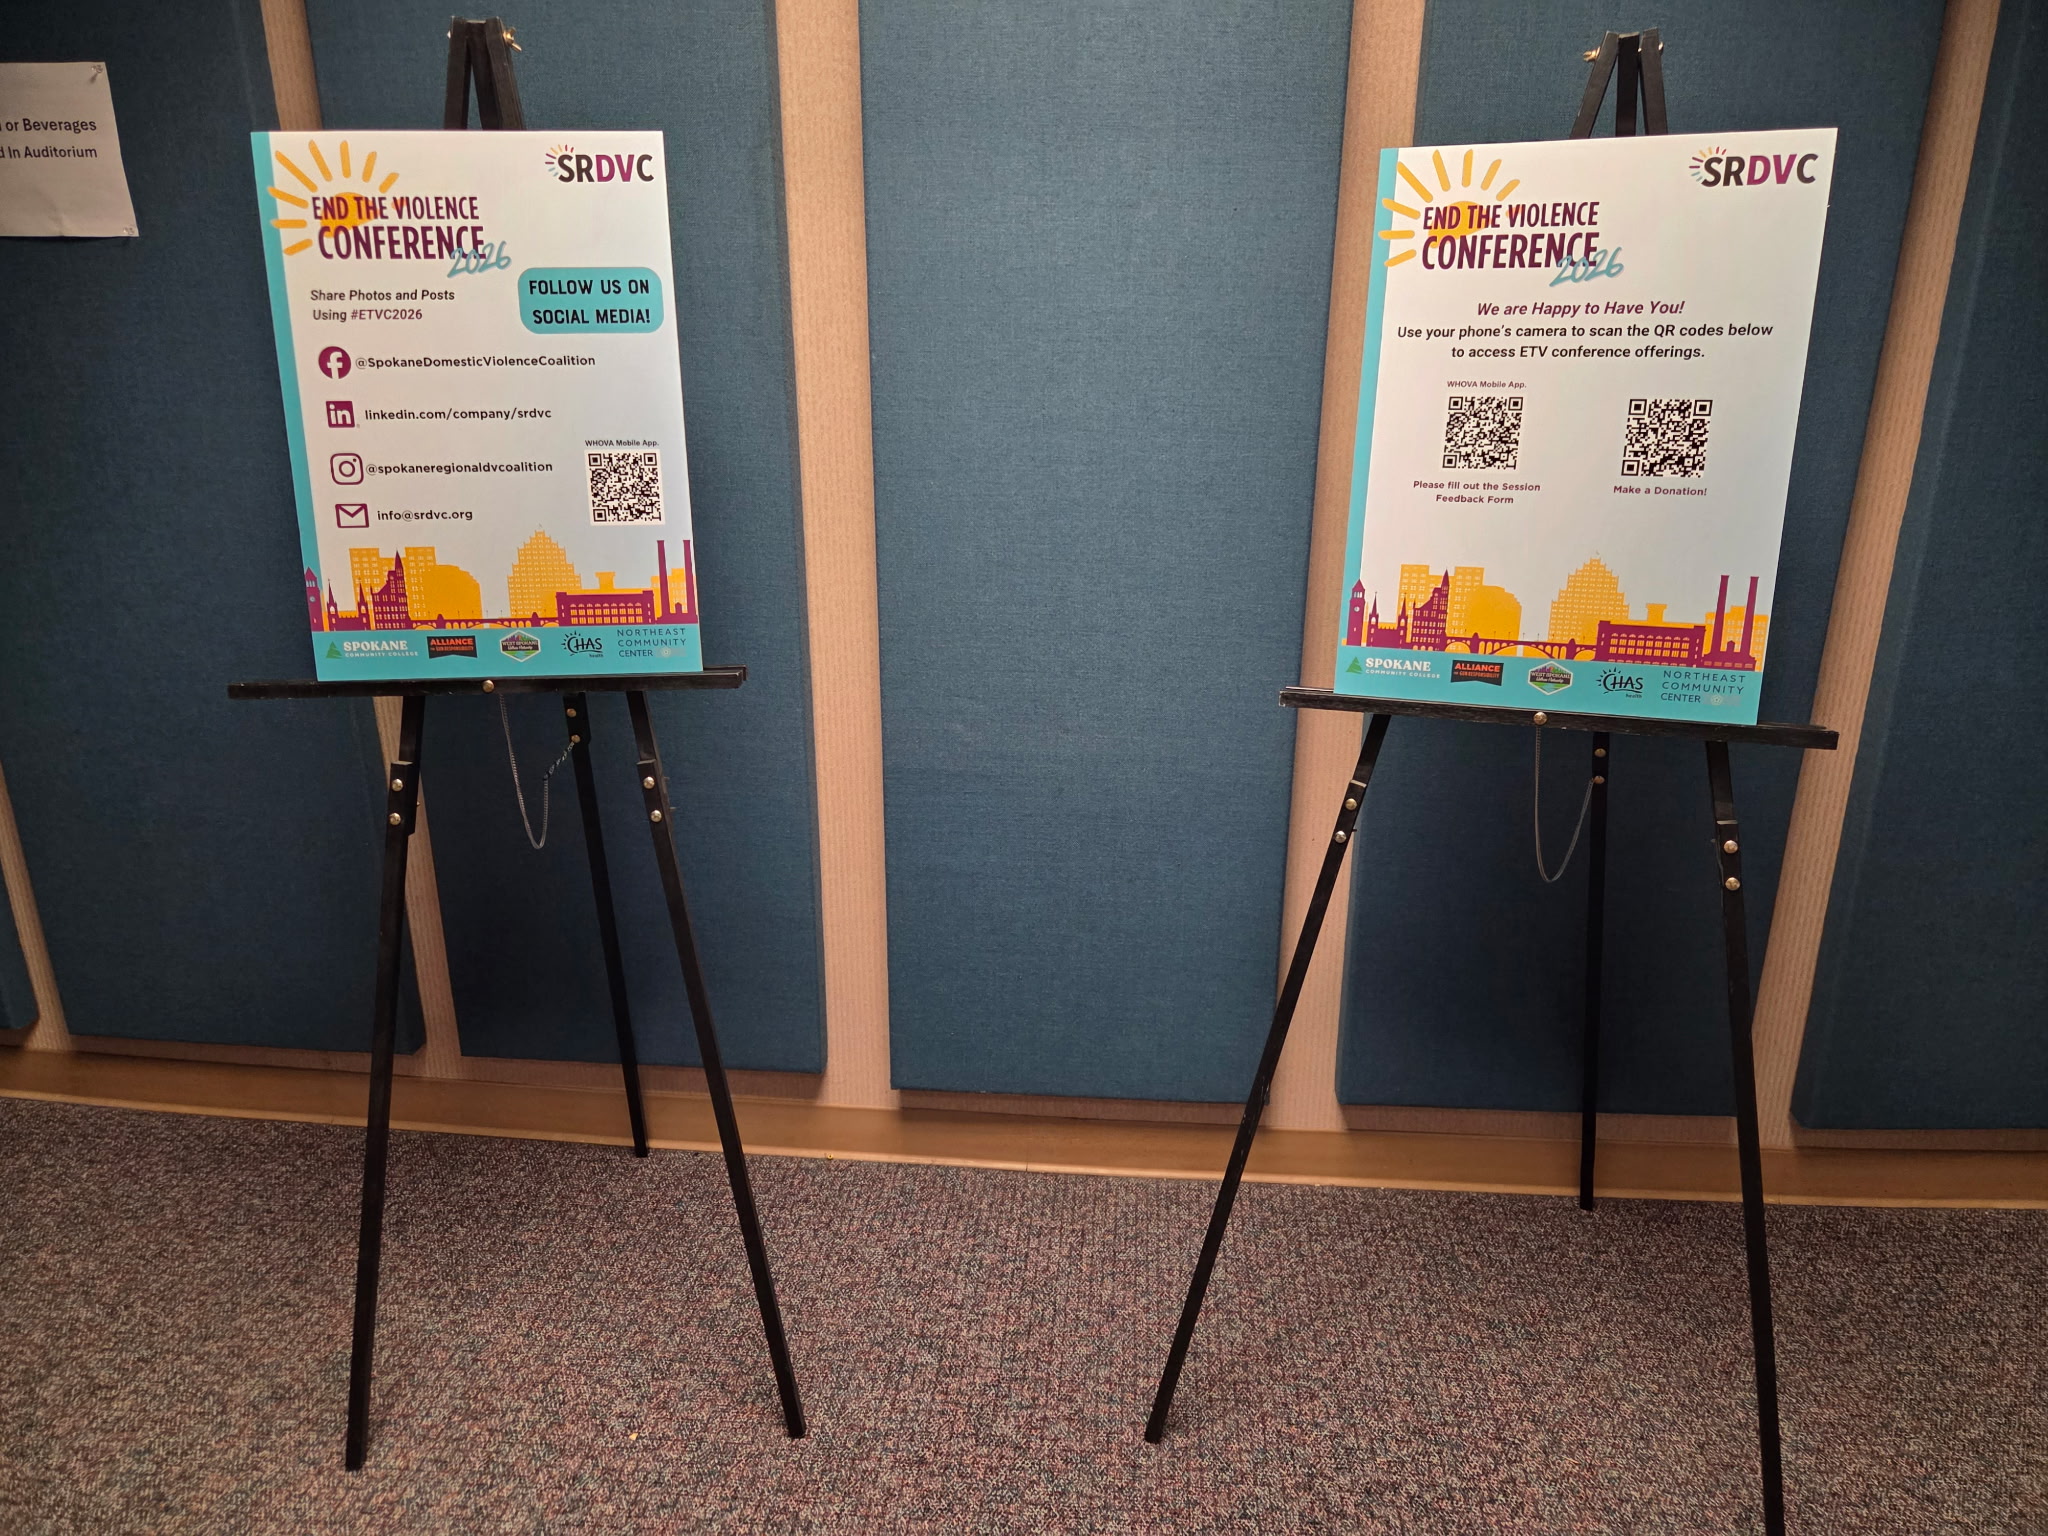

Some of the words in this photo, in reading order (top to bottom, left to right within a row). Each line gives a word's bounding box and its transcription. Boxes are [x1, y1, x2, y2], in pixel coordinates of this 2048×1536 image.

[6, 121, 19, 131] or
[23, 118, 97, 134] Beverages
[8, 146, 21, 158] In
[24, 146, 98, 158] Auditorium
[557, 154, 654, 183] SRDVC
[1701, 153, 1818, 188] SRDVC
[312, 196, 348, 221] END
[355, 197, 388, 220] THE
[393, 196, 480, 221] VIOLENCE
[1422, 204, 1461, 230] END
[1467, 204, 1500, 229] THE
[1506, 201, 1600, 228] VIOLENCE
[318, 225, 485, 261] CONFERENCE
[1422, 232, 1599, 270] CONFERENCE
[446, 241, 512, 279] 2026
[1549, 247, 1625, 287] 2026
[310, 289, 345, 301] Share
[349, 289, 392, 301] Photos
[395, 289, 417, 301] and
[421, 289, 455, 301] Posts
[528, 280, 592, 296] FOLLOW
[601, 280, 621, 295] US
[627, 280, 650, 295] ON
[312, 309, 347, 323] Using
[350, 308, 423, 321] #ETVC2026
[532, 309, 590, 325] SOCIAL
[596, 308, 651, 325] MEDIA!
[1477, 302, 1500, 316] We
[1503, 304, 1527, 315] are
[1531, 302, 1580, 319] Happy
[1584, 302, 1599, 314] to
[1604, 301, 1645, 315] Have
[1649, 300, 1684, 314] You!
[1398, 326, 1422, 338] Use
[1425, 328, 1454, 341] your
[1515, 326, 1567, 337] camera
[1571, 326, 1585, 337] to
[1589, 326, 1623, 337] scan
[1626, 324, 1650, 337] the
[1653, 324, 1676, 338] QR
[1679, 323, 1723, 337] codes
[1728, 323, 1773, 336] below
[1451, 347, 1464, 358] to
[1468, 347, 1515, 358] access
[1520, 346, 1548, 358] ETV
[1551, 344, 1632, 358] conference
[1635, 344, 1704, 361] offerings.
[355, 354, 596, 370] @SpokaneDomesticViolenceCoalition
[1508, 381, 1527, 389] App.
[365, 407, 552, 421] linkedin.com/company/srdvc
[585, 439, 614, 447] WHOVA
[616, 438, 641, 447] Mobile
[642, 439, 660, 448] App.
[366, 460, 553, 476] @spokaneregionaldvcoalition
[1413, 481, 1445, 489] Please
[1447, 481, 1461, 490] fill
[1464, 482, 1480, 490] out
[1482, 482, 1499, 490] the
[1502, 483, 1541, 491] Session
[1613, 485, 1641, 494] Make
[1654, 487, 1707, 496] Donation!
[1436, 495, 1484, 503] Feedback
[1487, 496, 1514, 504] Form
[377, 508, 473, 523] info@srdvc.org
[617, 628, 686, 637] NORTHEAST
[343, 640, 408, 651] SPOKANE
[430, 638, 473, 646] ALLIANCE
[567, 636, 603, 652] CHAS
[618, 639, 687, 647] COMMUNITY
[619, 650, 653, 658] CENTER
[1365, 658, 1431, 672] SPOKANE
[1454, 663, 1501, 672] ALLIANCE
[1603, 673, 1644, 692] CHAS
[1663, 670, 1746, 683] NORTHEAST
[1662, 682, 1744, 694] COMMUNITY
[1661, 693, 1701, 703] CENTER
